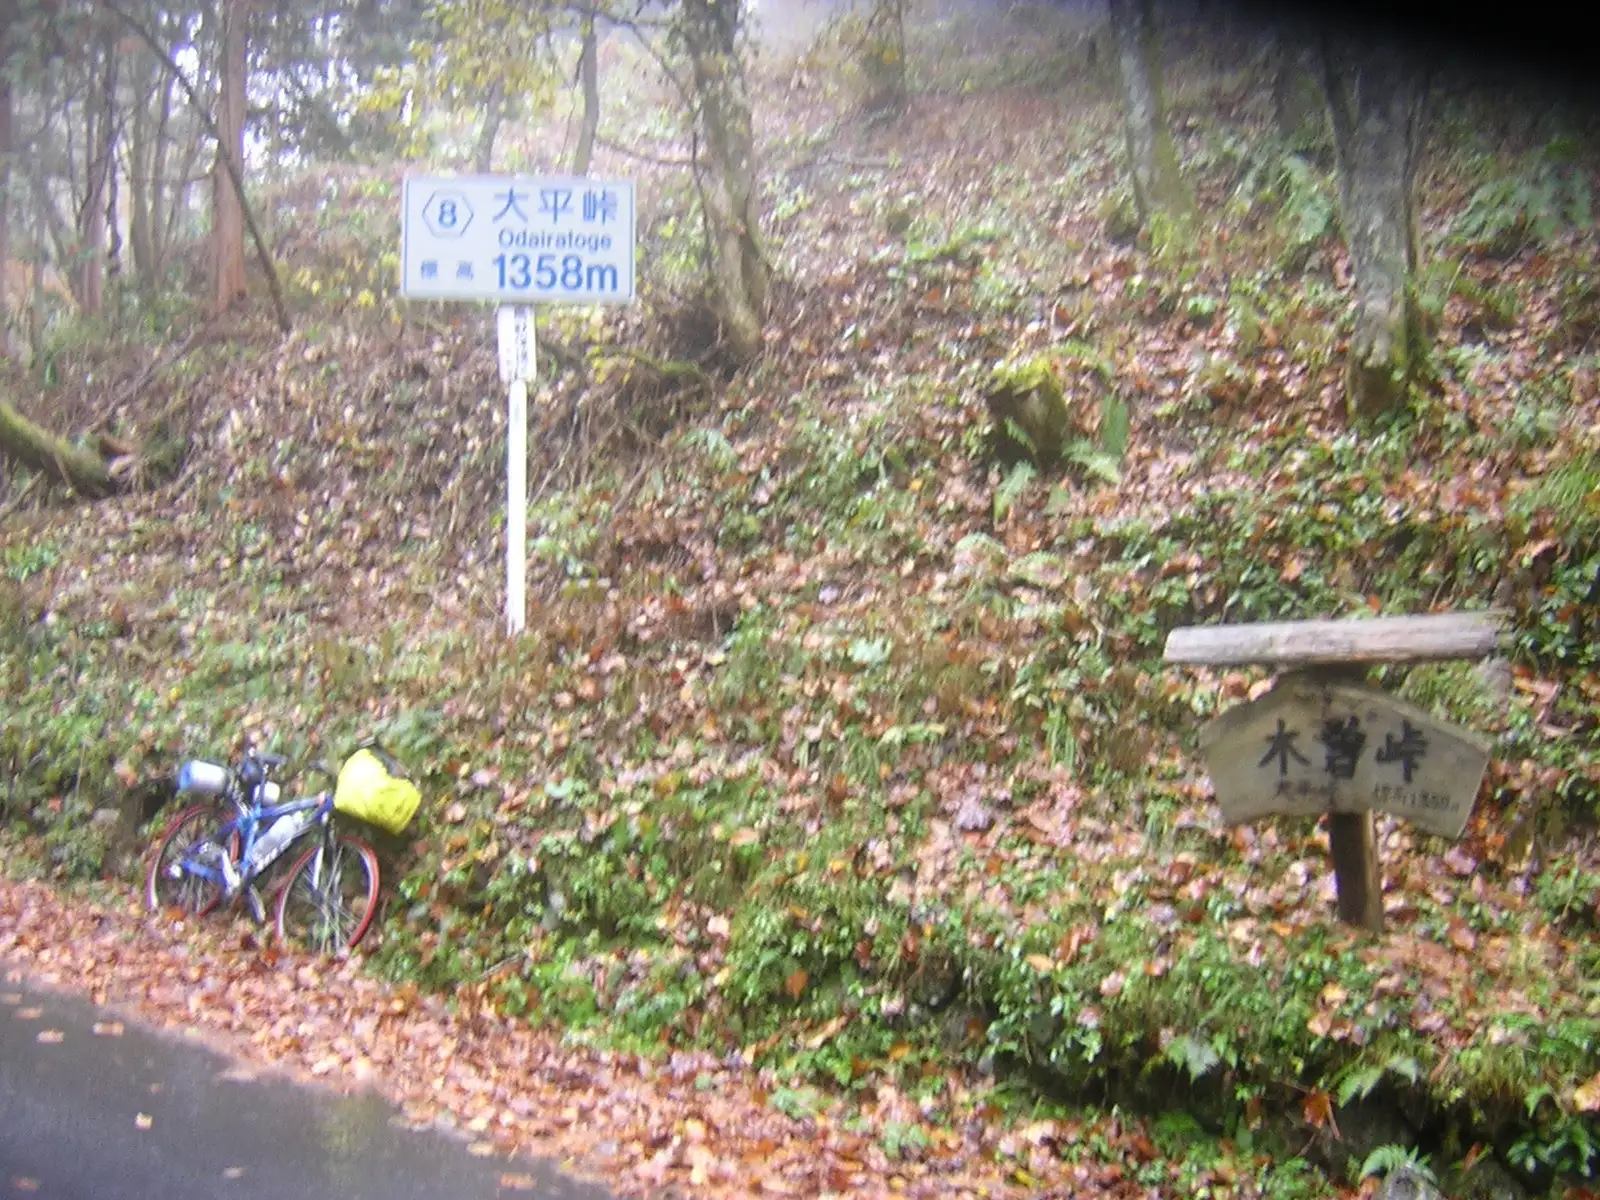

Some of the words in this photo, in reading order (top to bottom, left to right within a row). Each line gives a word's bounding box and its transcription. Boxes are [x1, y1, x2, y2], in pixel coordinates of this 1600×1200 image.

[438, 199, 457, 228] 8
[492, 187, 618, 225] 大平峠
[498, 228, 612, 252] Odairatoge
[492, 253, 618, 292] 1358m
